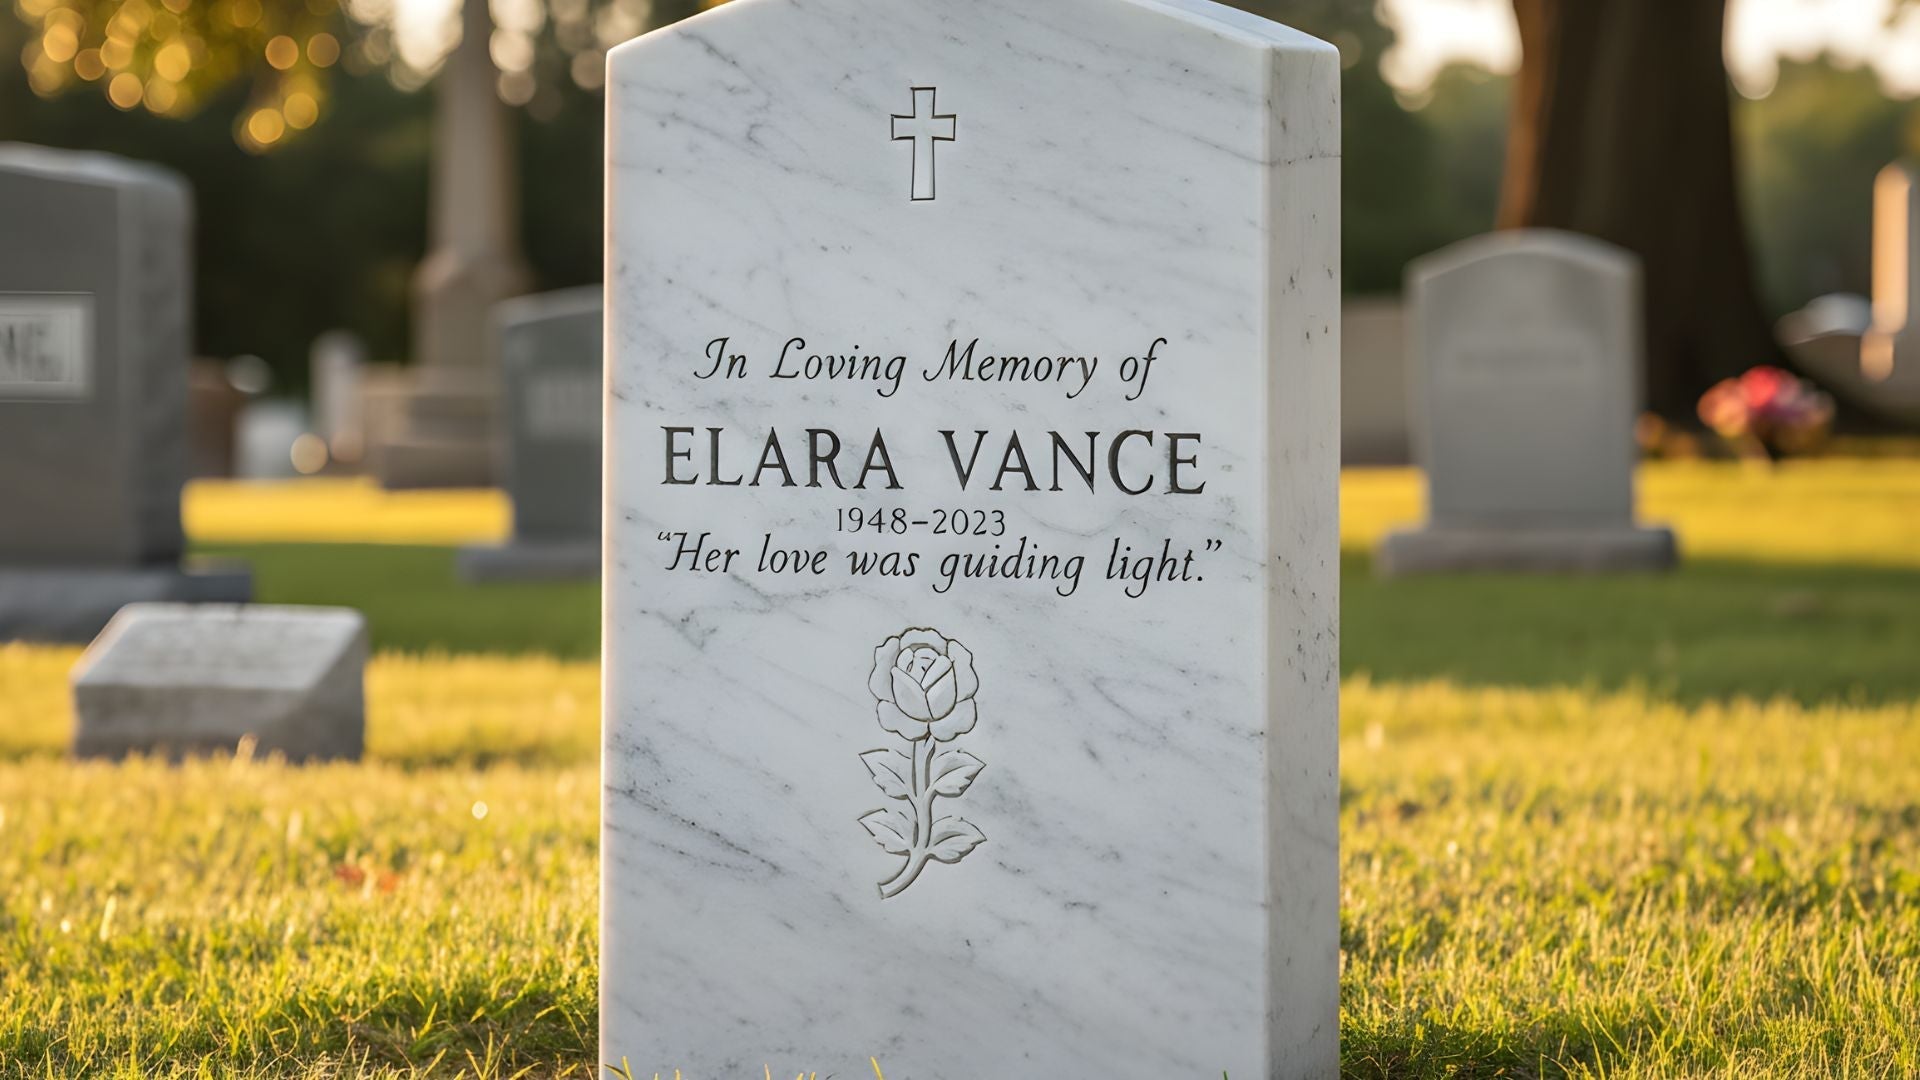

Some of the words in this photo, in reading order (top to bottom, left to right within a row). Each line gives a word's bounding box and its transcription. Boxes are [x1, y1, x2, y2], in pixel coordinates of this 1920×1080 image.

[693, 336, 748, 380] In
[768, 336, 907, 398] Loving
[922, 337, 1099, 400] Memory
[1119, 337, 1168, 402] of
[660, 425, 905, 491] ELARA
[937, 428, 1207, 496] VANCE
[757, 532, 828, 576] love
[845, 550, 921, 578] was
[931, 536, 1086, 598] guiding
